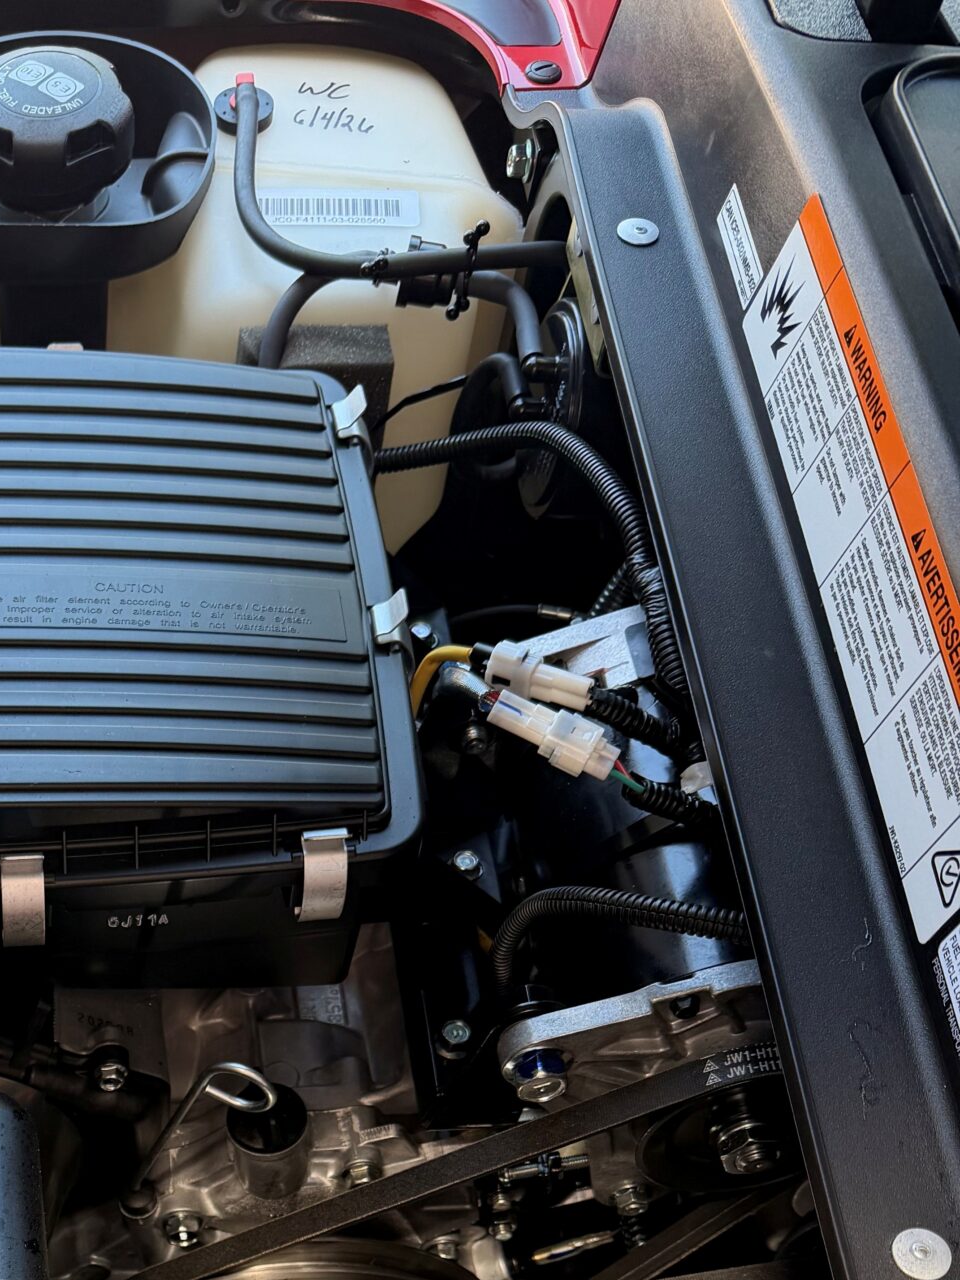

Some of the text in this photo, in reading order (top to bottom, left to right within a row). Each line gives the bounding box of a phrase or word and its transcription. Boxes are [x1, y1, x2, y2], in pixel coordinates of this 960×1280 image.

[21, 66, 42, 78] E10
[297, 81, 351, 100] WC
[21, 97, 84, 115] UNLEADED
[293, 105, 375, 134] 6/4/26
[850, 337, 886, 434] WARNING
[95, 582, 164, 594] CAUTION
[12, 595, 27, 603] air
[35, 594, 58, 604] filter
[67, 595, 111, 605] element
[119, 598, 171, 608] according
[180, 600, 191, 608] to
[6, 605, 56, 614] Improper
[64, 606, 103, 614] service
[132, 608, 182, 617] alteration
[191, 610, 202, 618] to
[210, 611, 224, 619] air
[234, 612, 266, 622] intake
[274, 615, 312, 625] system
[61, 617, 98, 625] engine
[107, 617, 151, 627] damage
[160, 618, 181, 627] that
[190, 619, 199, 628] is
[208, 621, 226, 629] not
[235, 624, 300, 634] warrantable.
[927, 671, 951, 740] VITESSE POURRAIT
[921, 679, 932, 705] PERTE
[928, 702, 935, 715] DE
[943, 752, 952, 769] QUI
[927, 728, 938, 752] DANS
[934, 749, 941, 762] LA
[937, 759, 952, 800] BLESSURE
[949, 934, 960, 960] FUEL
[940, 942, 958, 986] VEHICLE
[931, 957, 949, 1005] PERSONAL
